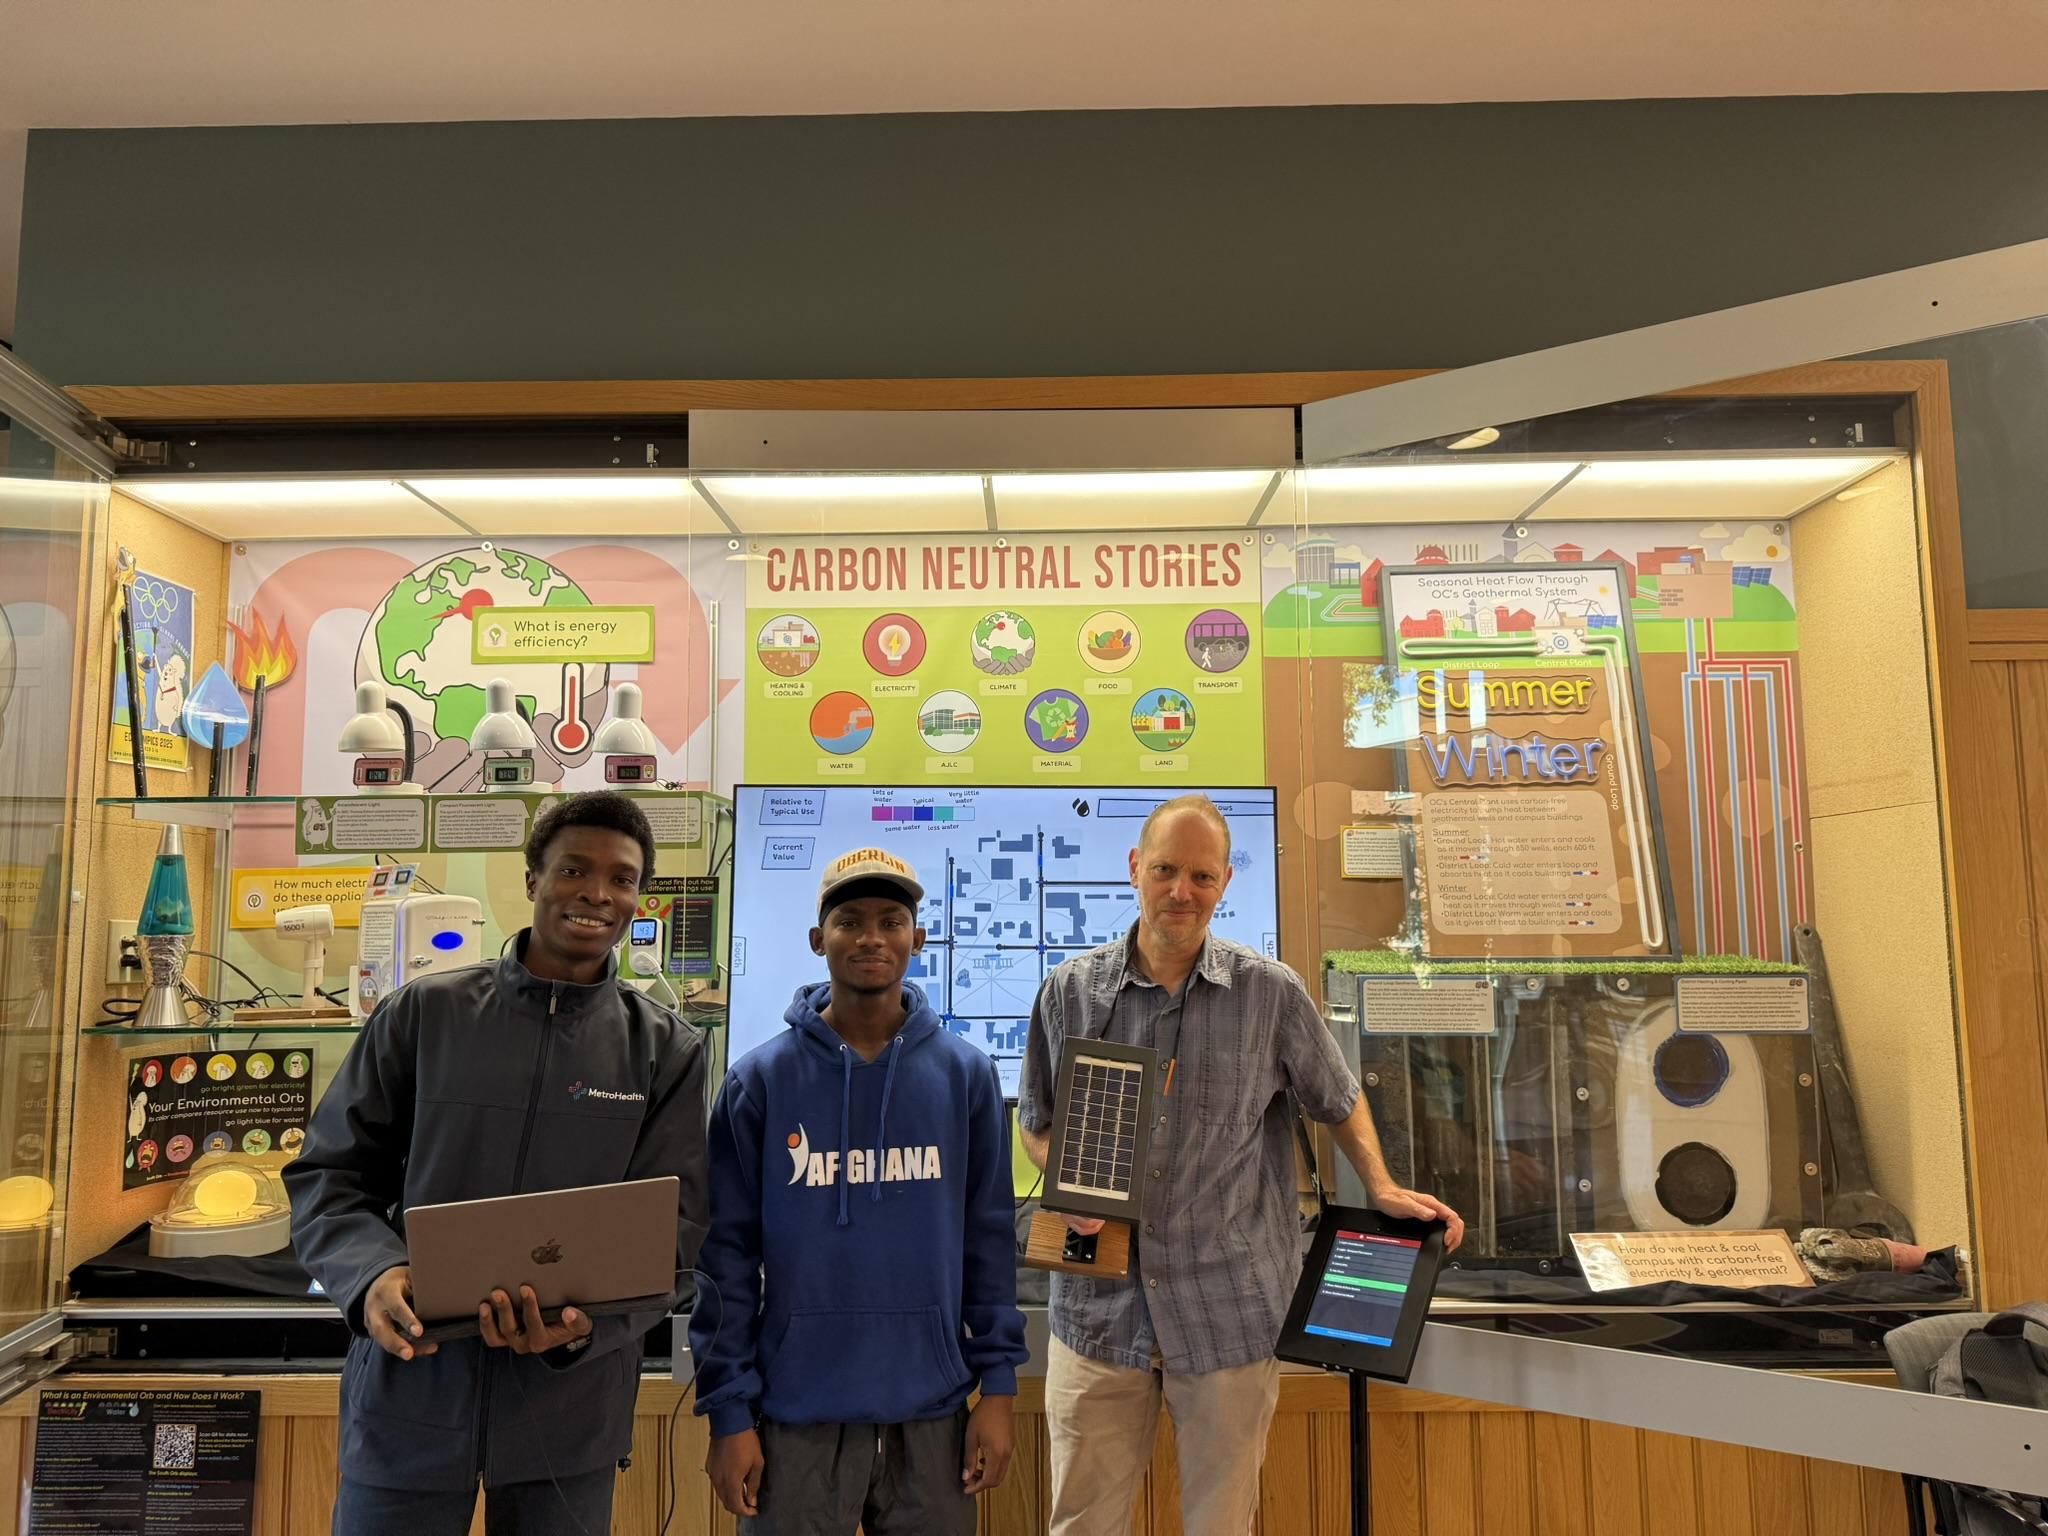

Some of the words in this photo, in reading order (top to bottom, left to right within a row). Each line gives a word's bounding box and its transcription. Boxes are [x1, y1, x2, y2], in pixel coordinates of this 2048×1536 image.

[766, 547, 907, 592] CARBON
[922, 545, 1080, 590] NEUTRAL
[1094, 543, 1242, 588] STORIES
[1418, 577, 1473, 588] Seasonal
[1476, 576, 1505, 587] Heat
[1508, 575, 1534, 586] Flow
[1538, 574, 1588, 586] Through
[1431, 588, 1459, 599] OC's
[1462, 587, 1532, 599] Geothermal
[1535, 587, 1578, 599] System
[514, 620, 551, 632] What
[554, 620, 566, 632] is
[570, 622, 617, 634] energy
[514, 635, 588, 649] efficiency?
[1442, 661, 1475, 669] District
[1478, 661, 1500, 670] Loop
[1535, 659, 1568, 668] Central
[1570, 658, 1593, 667] Plant
[770, 682, 798, 690] HEATING
[799, 682, 806, 690] &
[1417, 674, 1593, 710] Summer
[1423, 735, 1602, 779] Winter
[1606, 754, 1617, 786] Ground
[1610, 788, 1619, 810] Loop
[770, 808, 799, 816] Typical
[837, 849, 905, 874] OBERLIN
[274, 880, 298, 889] How
[301, 880, 332, 889] much
[336, 879, 368, 888] electr
[273, 893, 288, 902] do
[291, 892, 322, 902] these
[326, 892, 363, 903] applia
[734, 942, 743, 968] South
[212, 1085, 236, 1093] bright
[237, 1084, 258, 1092] green
[271, 1082, 306, 1091] electricity!
[588, 1088, 645, 1101] MetroHealth
[148, 1102, 173, 1113] Your
[178, 1094, 276, 1110] Environmental
[279, 1093, 305, 1104] Orb
[155, 1114, 170, 1122] color
[170, 1111, 203, 1121] compares
[271, 1106, 293, 1114] typical
[225, 1120, 236, 1128] go
[237, 1118, 254, 1127] light
[283, 1116, 305, 1124] water!
[847, 1146, 942, 1184] GHANA
[1618, 1244, 1646, 1255] How
[1649, 1244, 1666, 1254] do
[1669, 1245, 1685, 1254] we
[1689, 1244, 1717, 1254] heat
[1719, 1243, 1730, 1253] &
[1733, 1242, 1761, 1252] cool
[1624, 1257, 1677, 1268] campus
[1678, 1255, 1704, 1265] with
[1706, 1254, 1784, 1265] carbon-free
[1629, 1268, 1692, 1280] electricity
[1695, 1268, 1705, 1277] &
[1707, 1266, 1788, 1279] geothermal?
[42, 1391, 62, 1399] What
[63, 1391, 69, 1399] is
[82, 1391, 138, 1400] Environmental
[139, 1391, 155, 1400] Orb
[156, 1391, 171, 1399] and
[173, 1391, 190, 1400] How
[191, 1391, 212, 1400] Does
[213, 1391, 219, 1400] it
[220, 1391, 245, 1400] Work?
